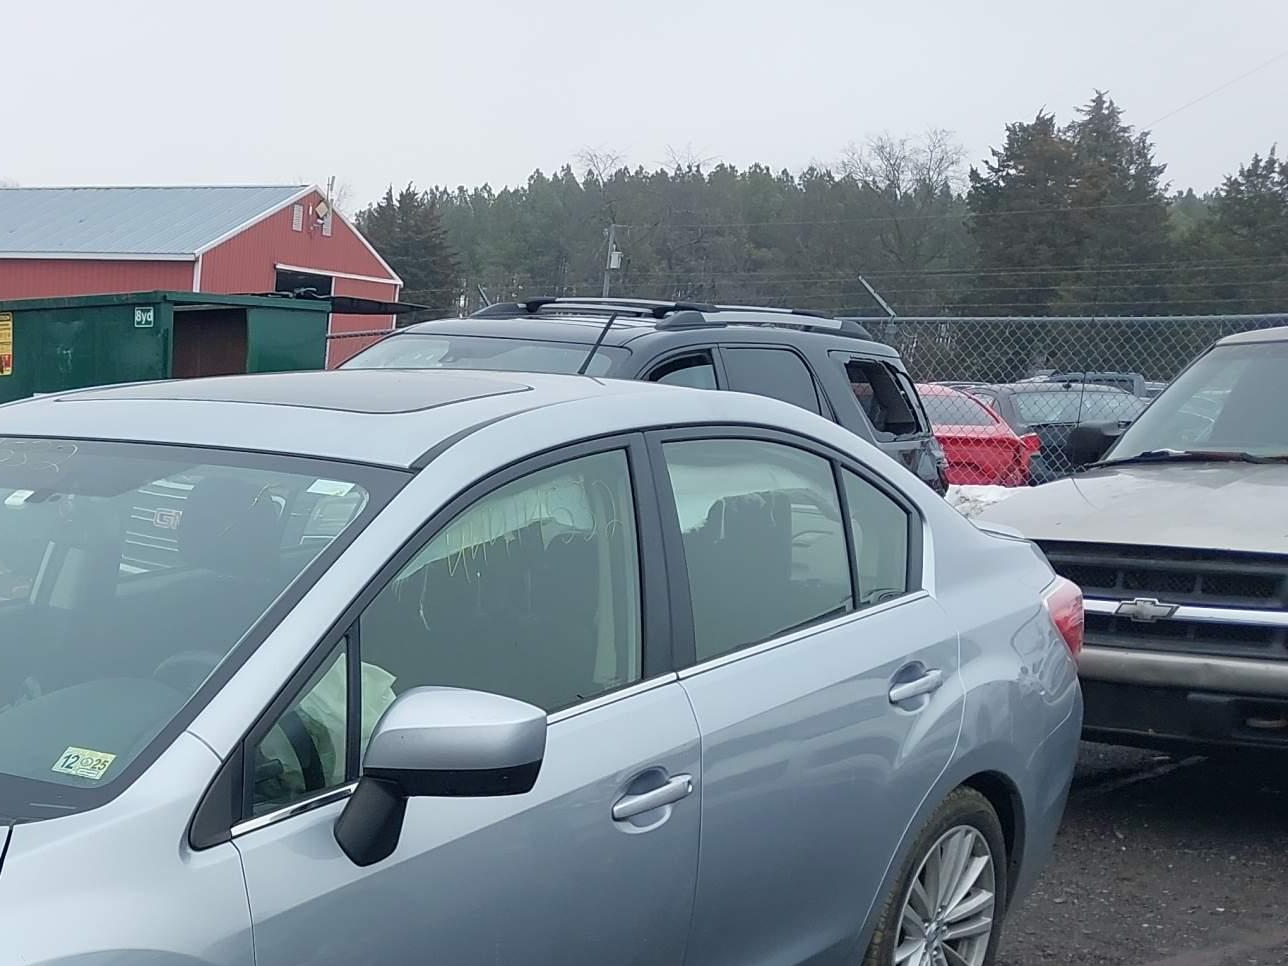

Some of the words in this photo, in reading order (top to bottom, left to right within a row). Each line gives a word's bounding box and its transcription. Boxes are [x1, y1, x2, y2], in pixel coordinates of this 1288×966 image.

[135, 309, 153, 325] 8yd
[60, 753, 80, 770] 12
[91, 758, 109, 771] 25
